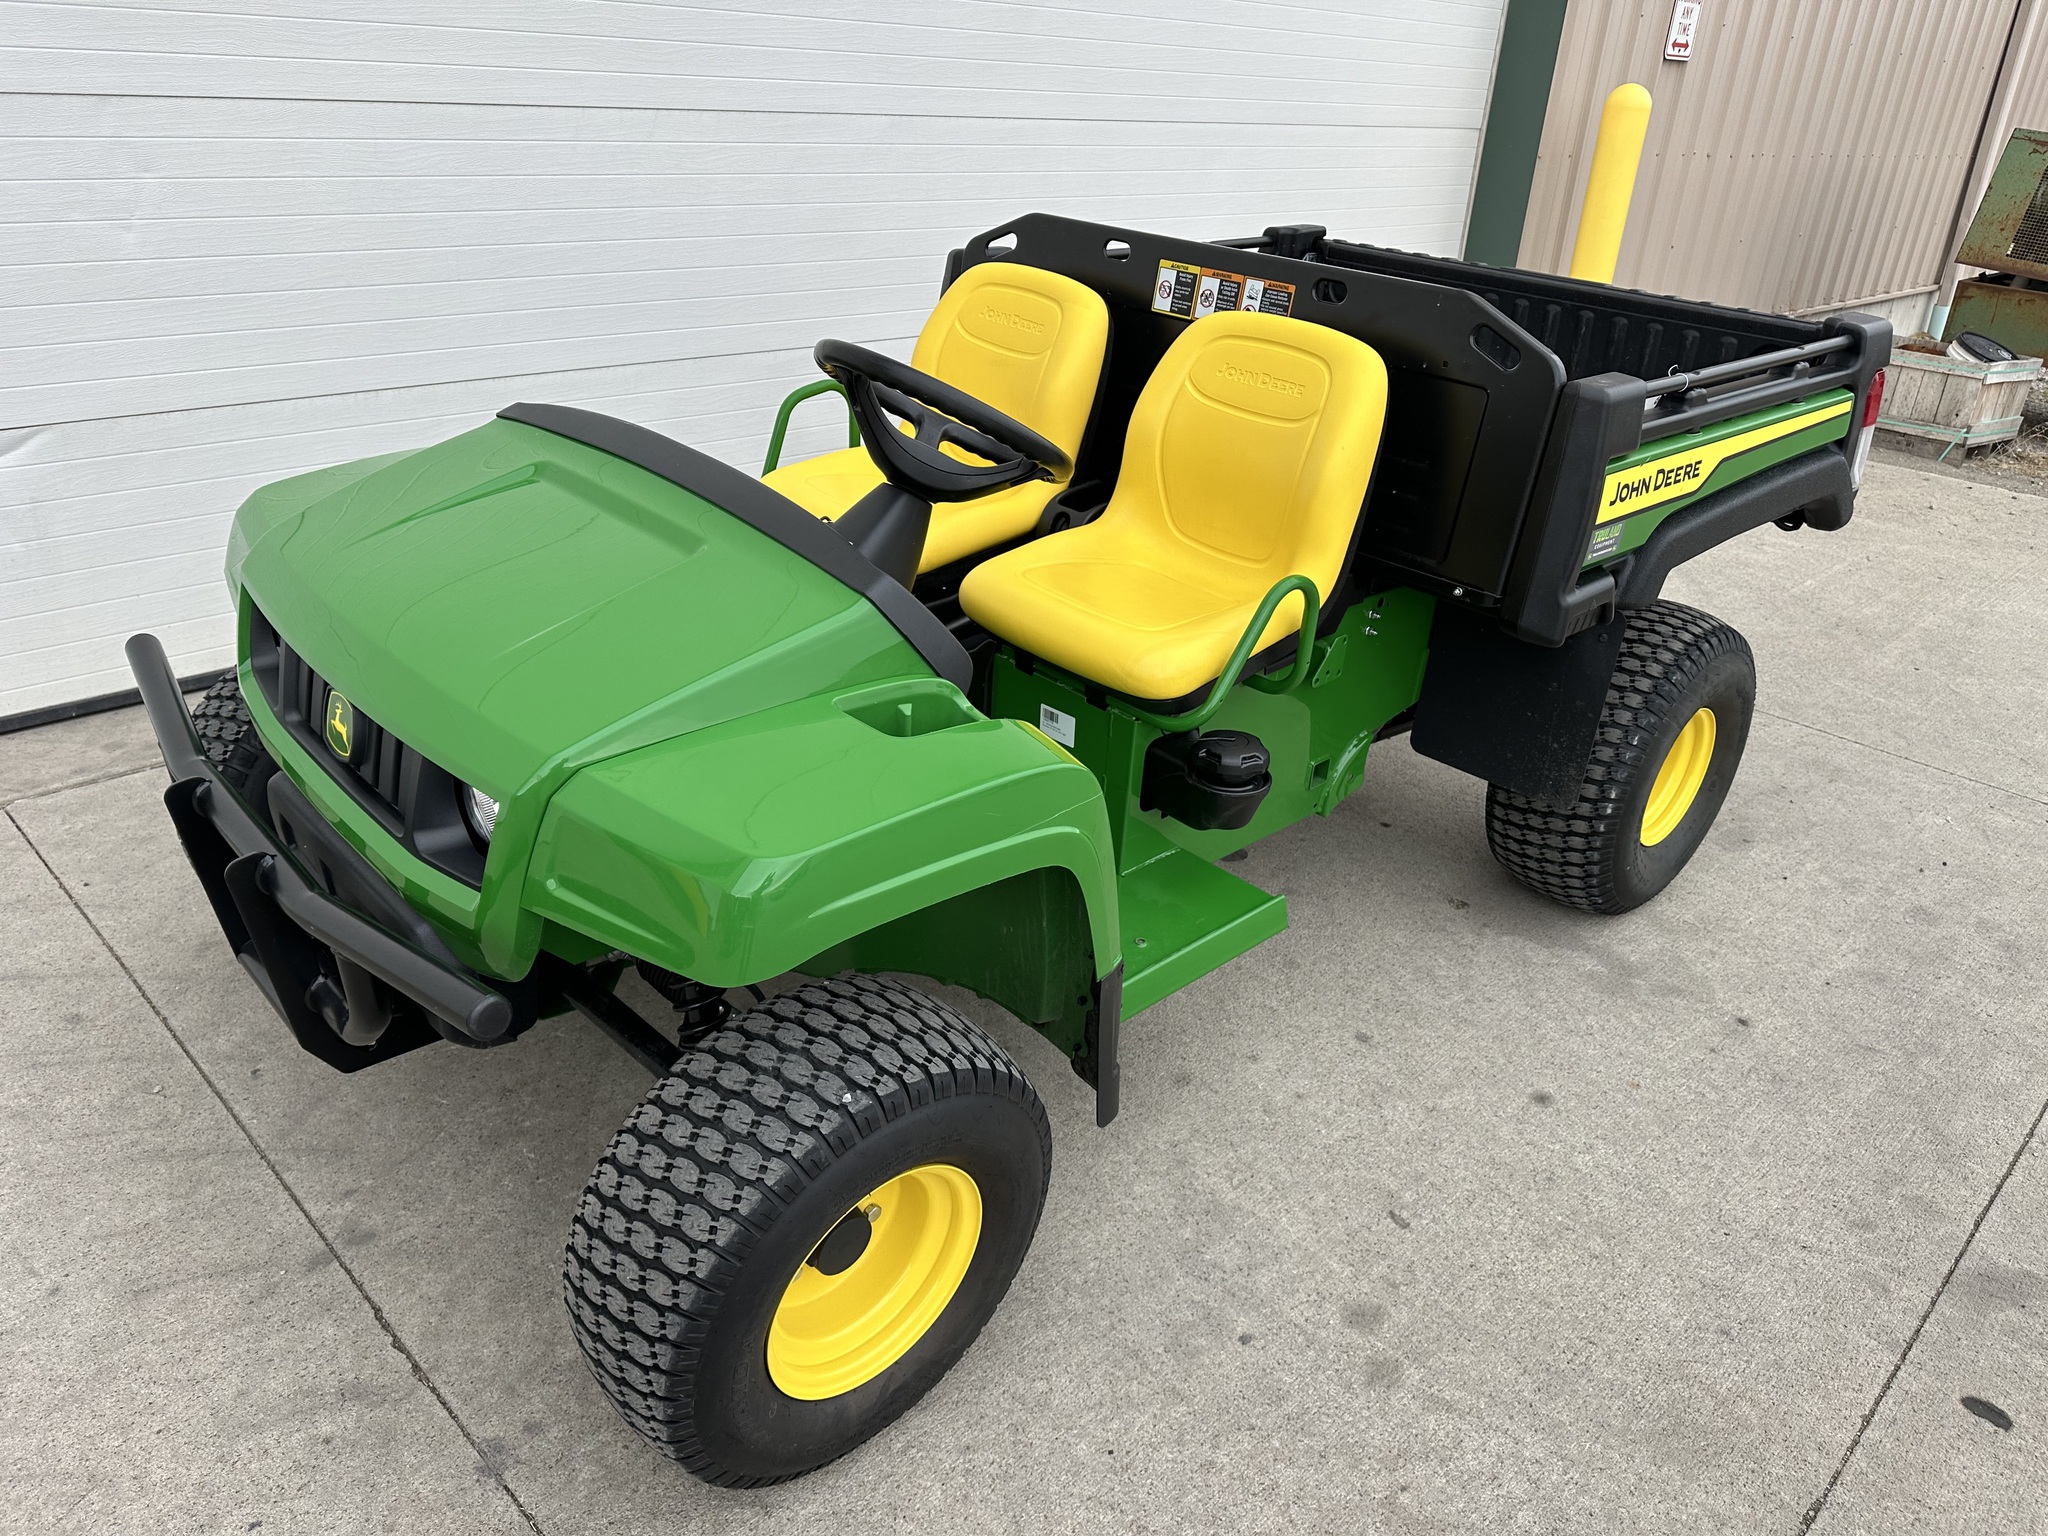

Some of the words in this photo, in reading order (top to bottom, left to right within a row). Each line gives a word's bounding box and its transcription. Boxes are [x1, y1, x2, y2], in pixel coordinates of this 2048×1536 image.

[1681, 6, 1694, 20] ANY
[1677, 22, 1691, 36] TIME
[979, 305, 1011, 326] JOHN
[1009, 314, 1045, 335] DEERE
[1216, 362, 1258, 386] JOHN
[1257, 373, 1306, 398] DEERE
[1609, 475, 1652, 506] JOHN
[1653, 460, 1702, 491] DEERE
